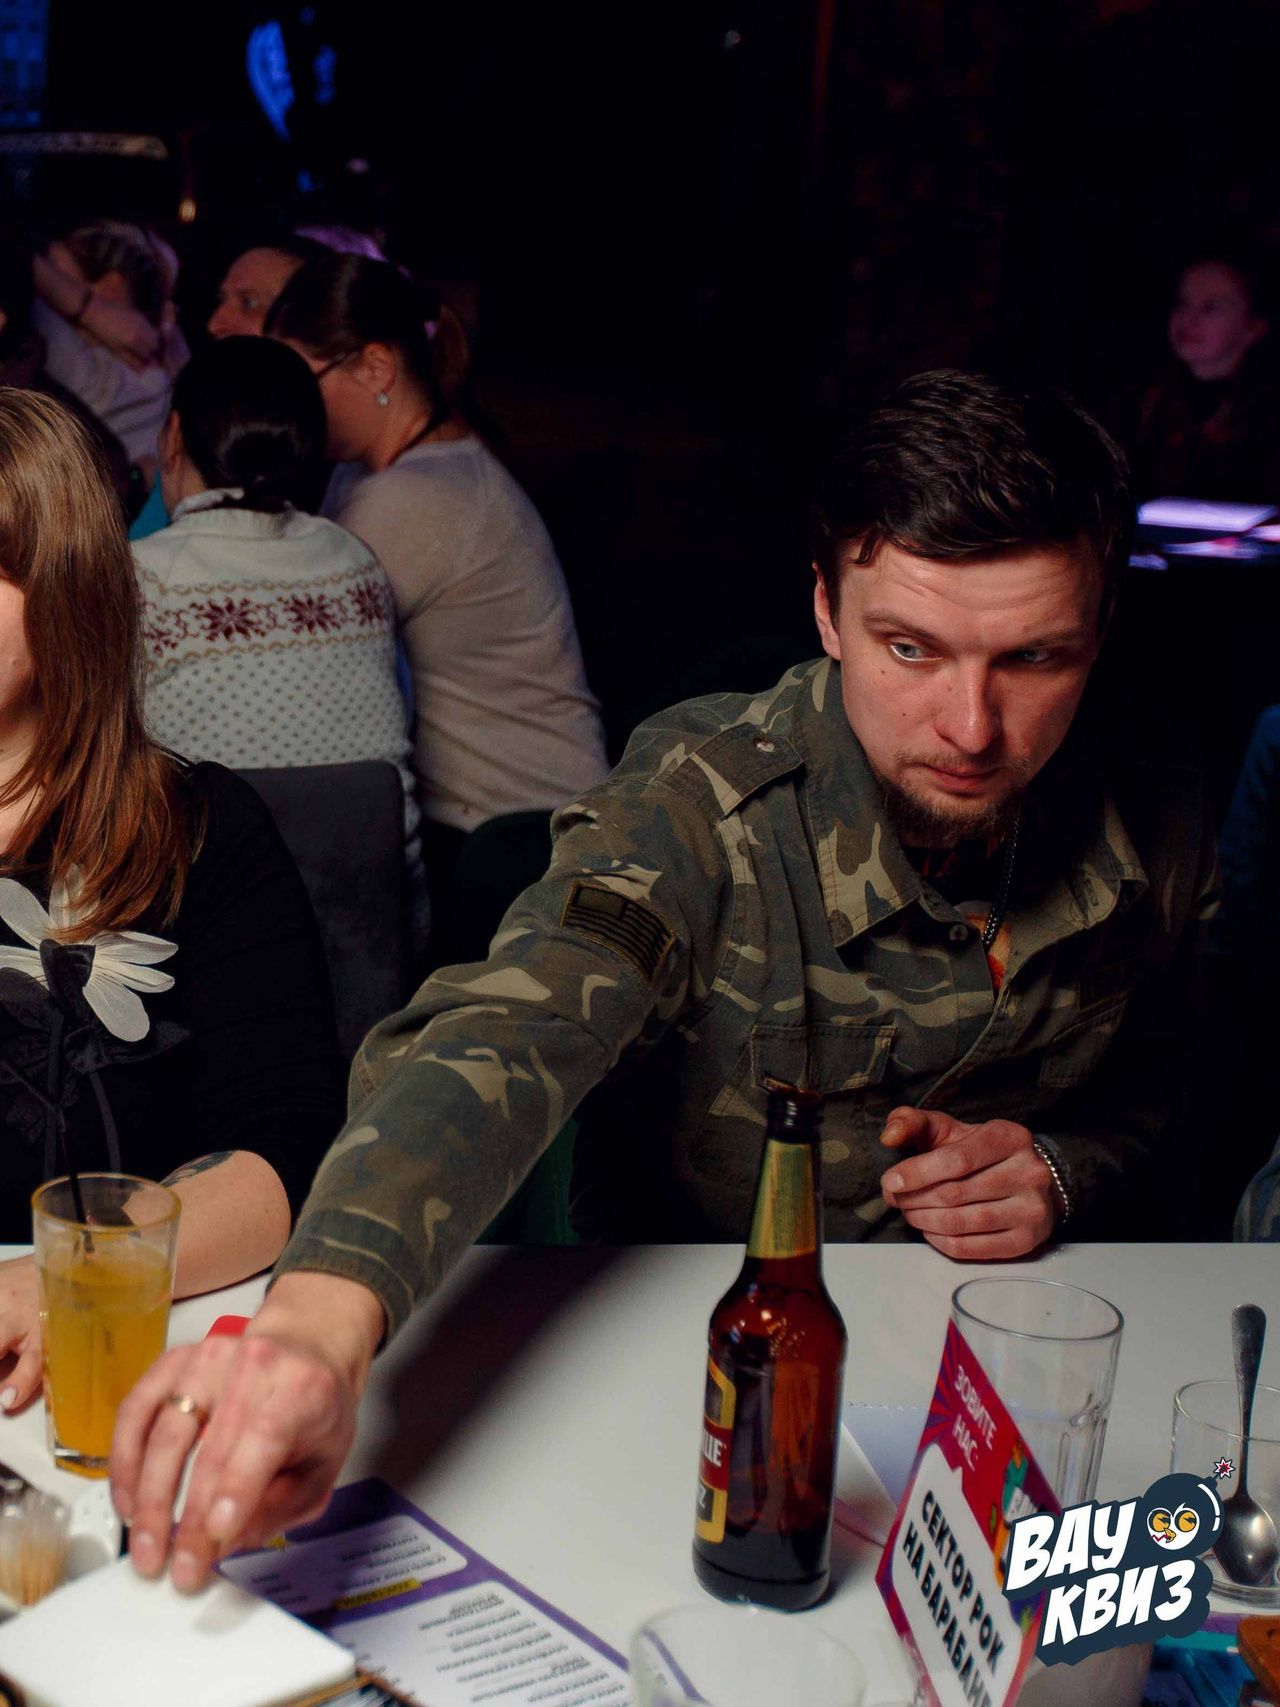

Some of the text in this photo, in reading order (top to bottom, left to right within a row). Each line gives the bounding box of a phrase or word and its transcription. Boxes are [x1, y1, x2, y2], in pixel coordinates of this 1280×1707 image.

[954, 1364, 997, 1450] ЗОВИТЕ
[903, 1521, 926, 1581] НА
[922, 1490, 1004, 1676] СЕКТОР РОК
